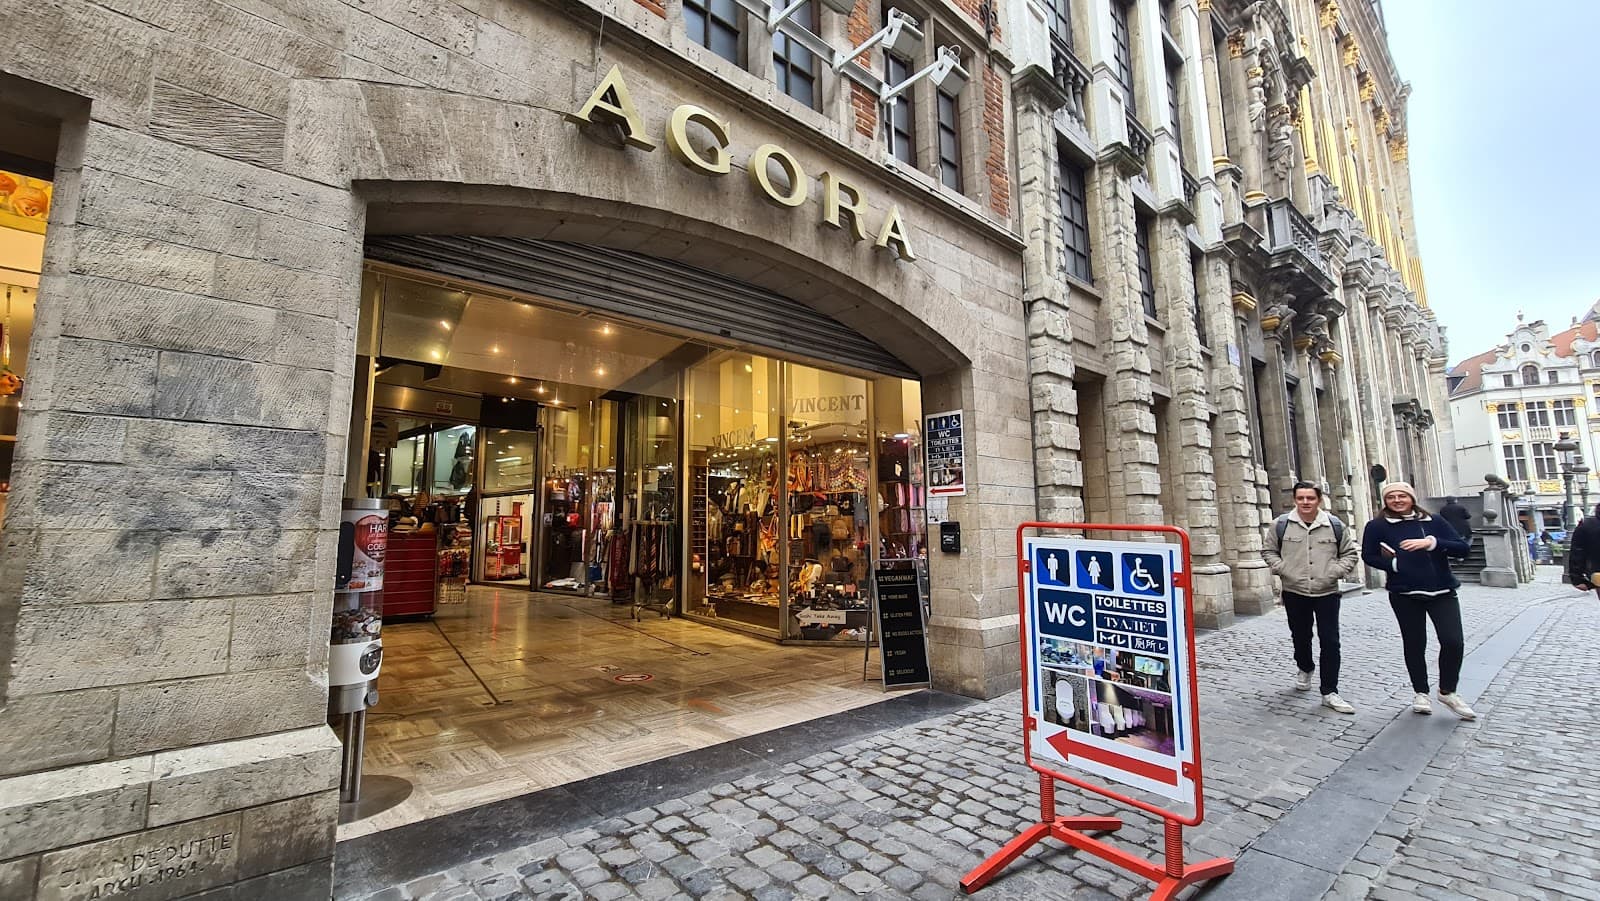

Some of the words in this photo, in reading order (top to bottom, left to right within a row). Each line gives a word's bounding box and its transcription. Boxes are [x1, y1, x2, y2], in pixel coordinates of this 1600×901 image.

[563, 63, 916, 262] AGORA
[938, 430, 951, 438] WC
[1096, 595, 1165, 614] TOILETTES
[1044, 601, 1086, 627] WC
[1103, 616, 1158, 634] ТУАЛЕТ
[1099, 632, 1126, 645] トイレ
